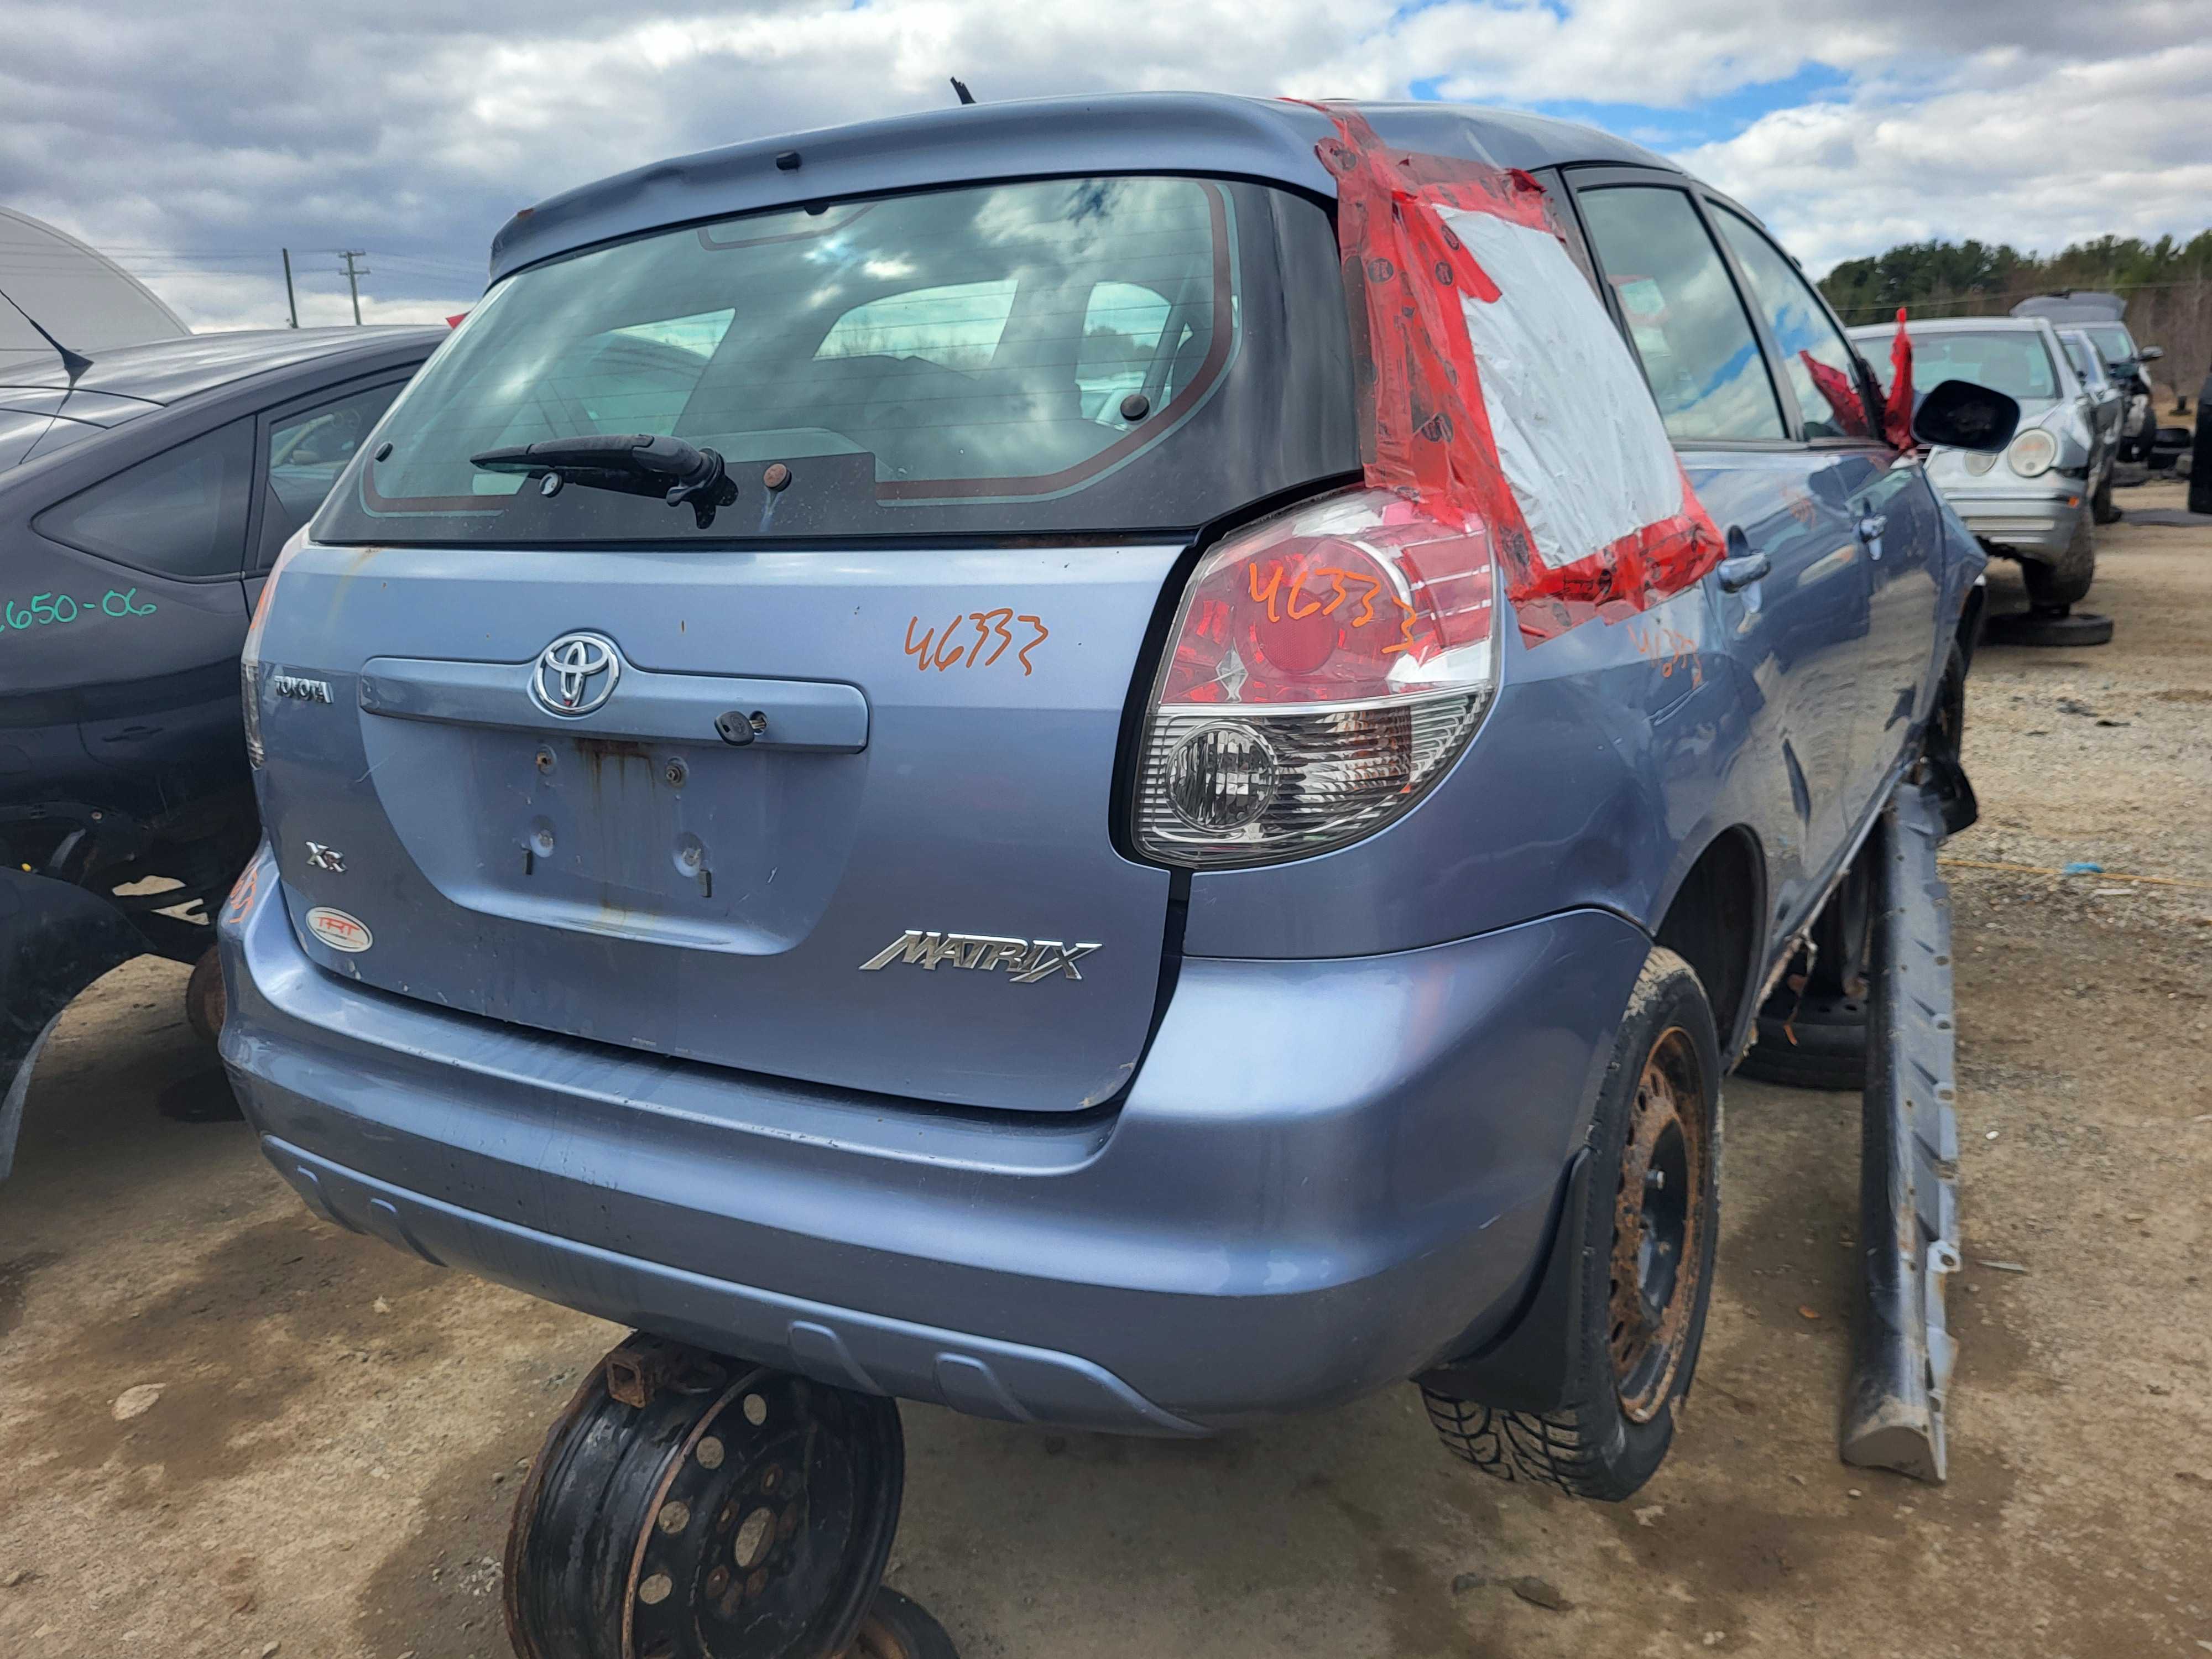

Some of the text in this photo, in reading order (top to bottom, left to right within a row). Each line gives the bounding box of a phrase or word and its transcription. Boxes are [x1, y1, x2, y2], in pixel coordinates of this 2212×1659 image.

[0, 587, 157, 632] 650-06
[1249, 562, 1417, 654] 46333
[904, 608, 1049, 676] 46333
[274, 675, 334, 703] TOYOTA
[858, 930, 1103, 983] MATRIX
